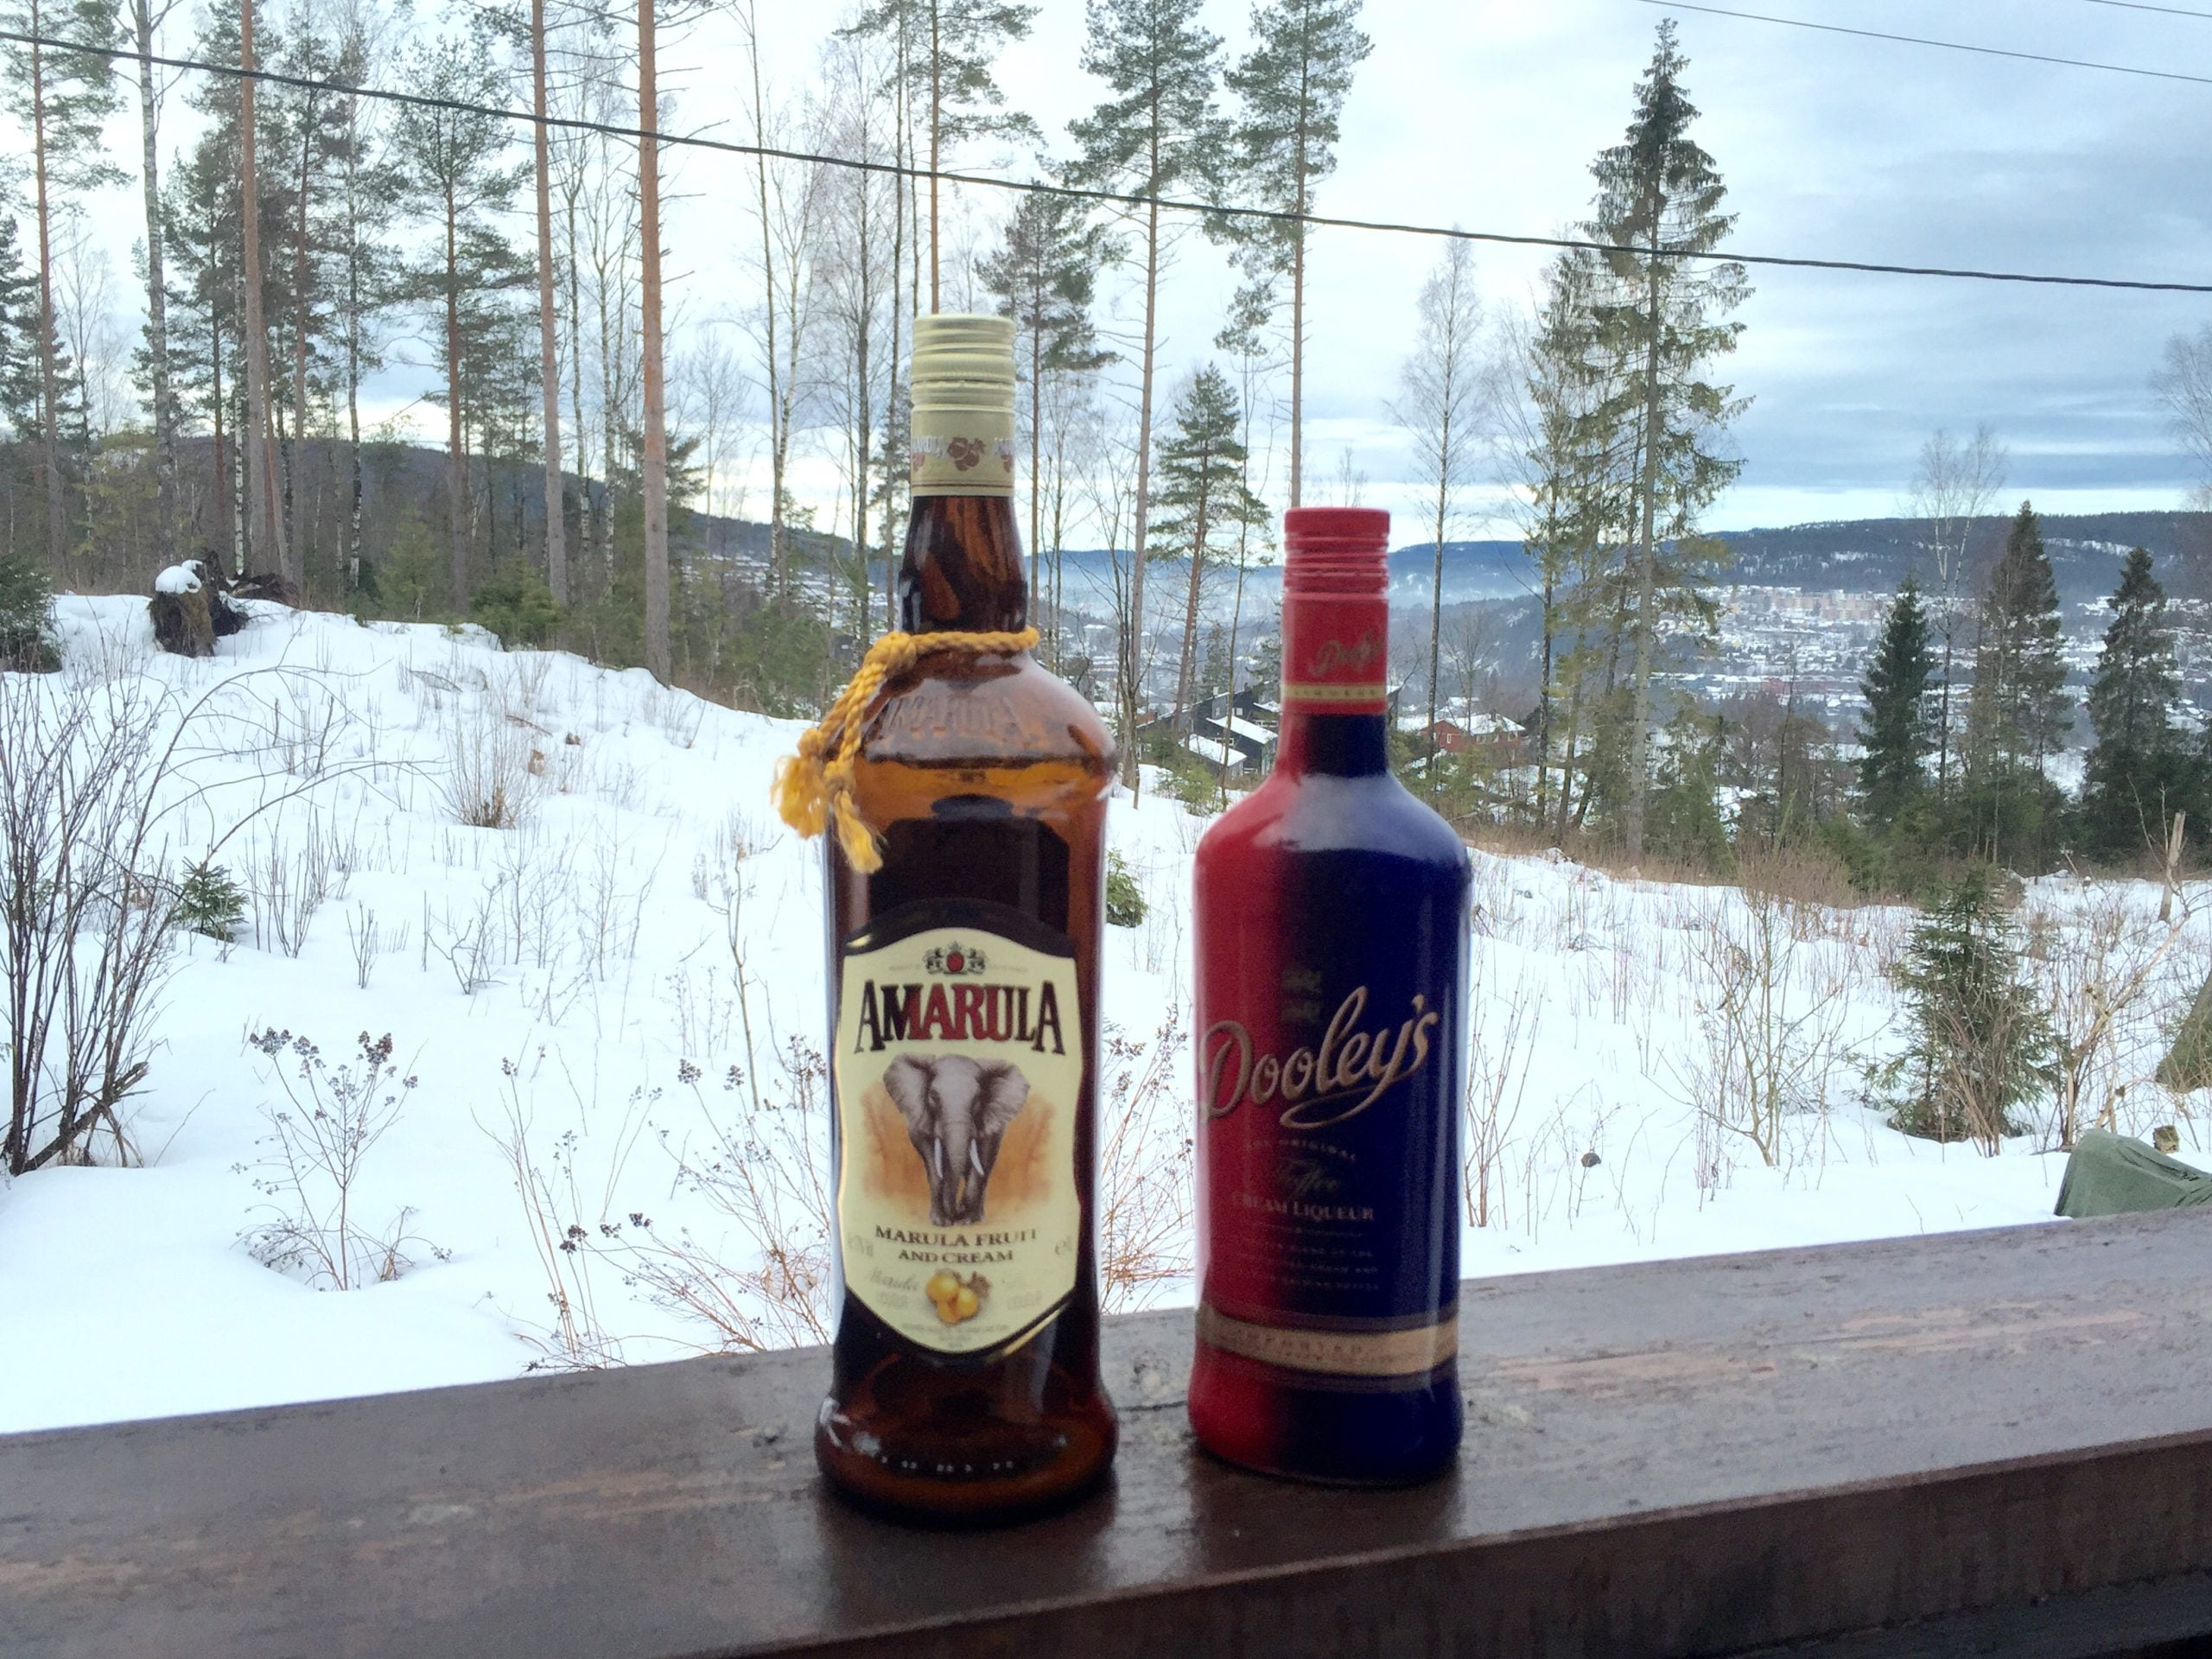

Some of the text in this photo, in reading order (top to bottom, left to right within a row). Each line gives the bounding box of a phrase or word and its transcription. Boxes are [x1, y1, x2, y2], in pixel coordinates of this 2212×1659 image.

[853, 978, 1066, 1056] AMARULA
[1198, 984, 1440, 1130] Dooley's
[1293, 1200, 1376, 1223] LIQUEUR
[874, 1224, 969, 1248] MARULA
[898, 1249, 1014, 1264] AND CREAM
